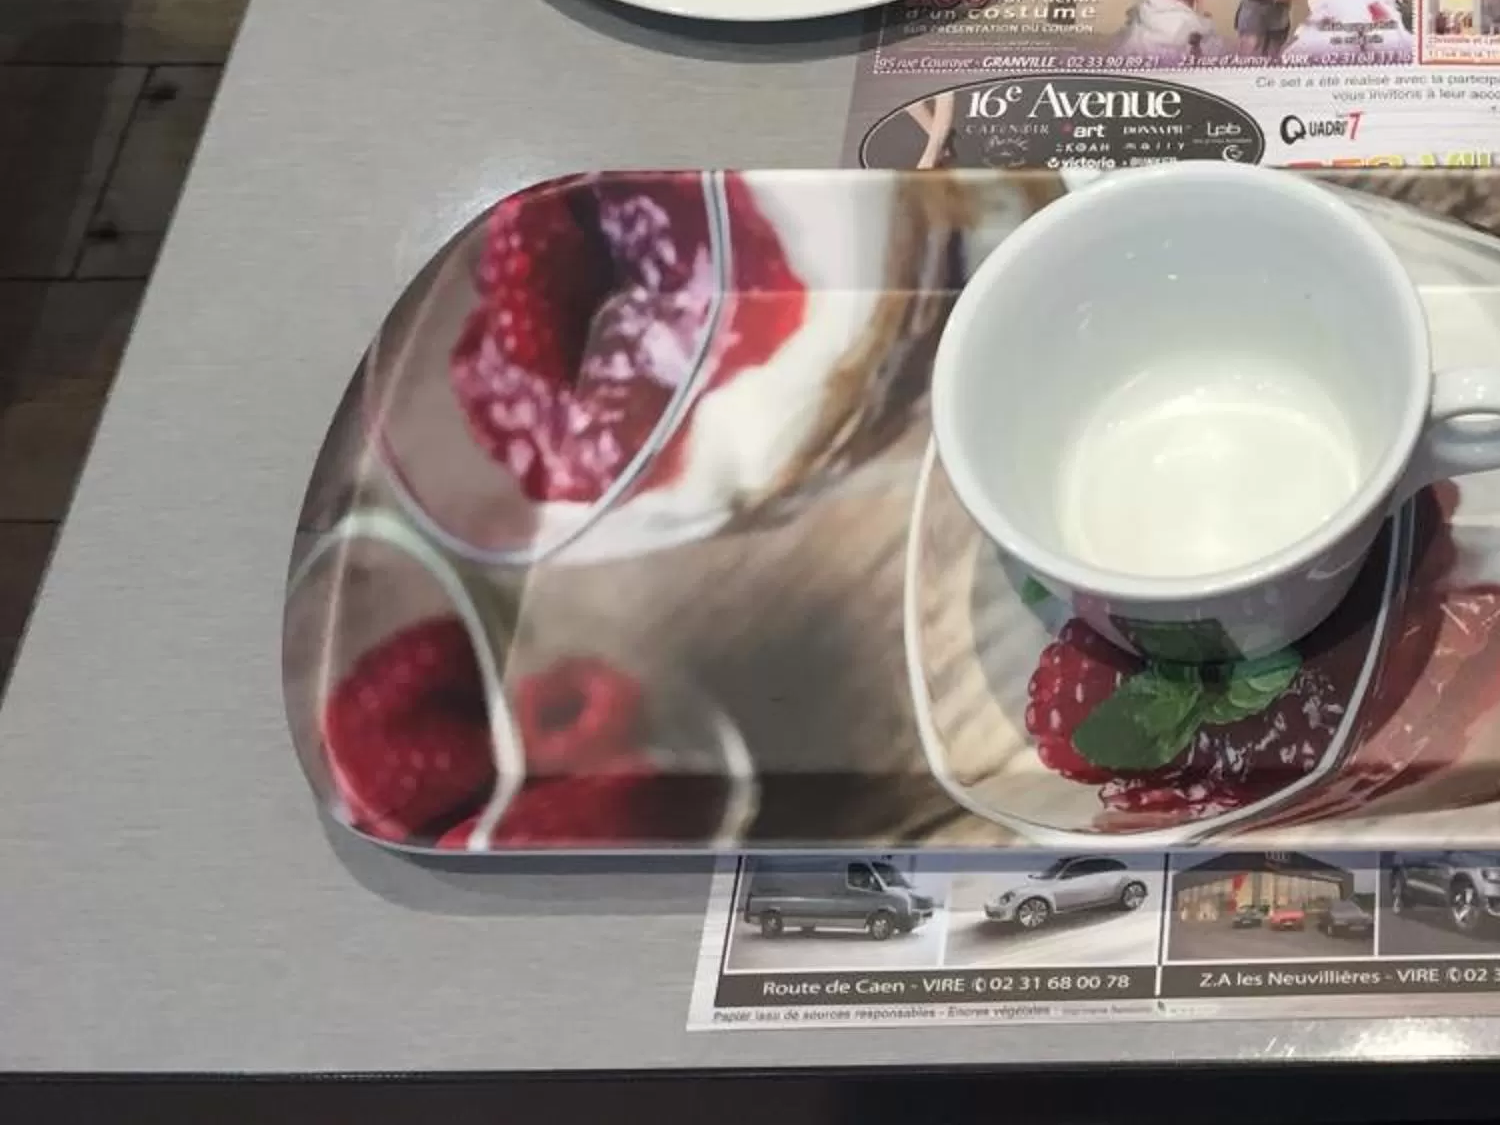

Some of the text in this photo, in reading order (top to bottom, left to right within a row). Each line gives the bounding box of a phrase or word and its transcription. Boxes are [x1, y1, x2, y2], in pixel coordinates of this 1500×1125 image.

[968, 7, 1097, 22] costume
[982, 56, 1057, 69] GRANVILLE
[1280, 76, 1303, 88] set
[1394, 76, 1427, 86] avec
[1025, 82, 1182, 118] Avenue
[1332, 91, 1365, 102] vous
[1440, 88, 1465, 100] leur
[1072, 123, 1106, 138] art
[1200, 972, 1231, 987] Z.A
[1237, 971, 1263, 987] les
[1267, 968, 1381, 986] Neuvillières
[1397, 968, 1440, 984] VIRE
[1464, 967, 1488, 982] 02
[762, 973, 1131, 997] Route de Caen VIRE 02 31 68 00 78
[713, 1010, 751, 1024] Papier
[783, 1009, 801, 1021] de
[803, 1010, 851, 1021] sources
[854, 1008, 937, 1023] responsables
